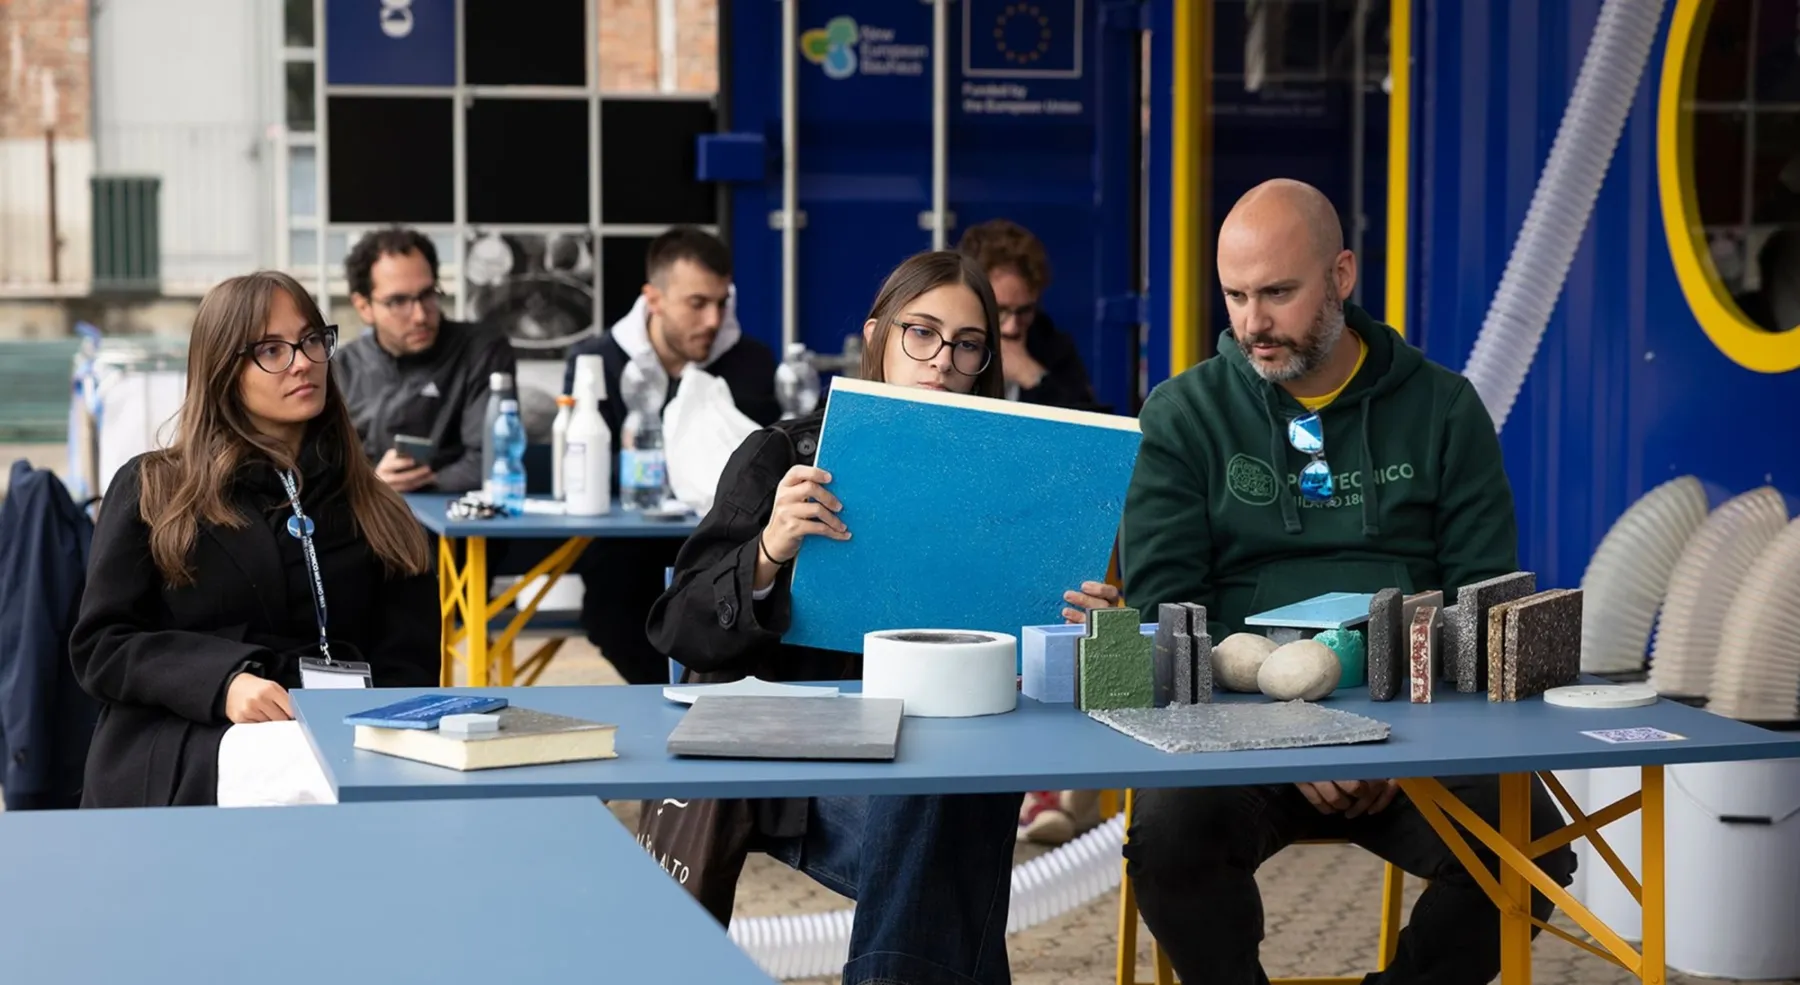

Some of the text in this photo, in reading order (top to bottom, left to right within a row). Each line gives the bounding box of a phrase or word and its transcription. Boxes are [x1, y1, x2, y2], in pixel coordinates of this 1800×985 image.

[860, 43, 929, 59] European
[962, 82, 1027, 99] Funded by
[963, 98, 1082, 116] the European Union
